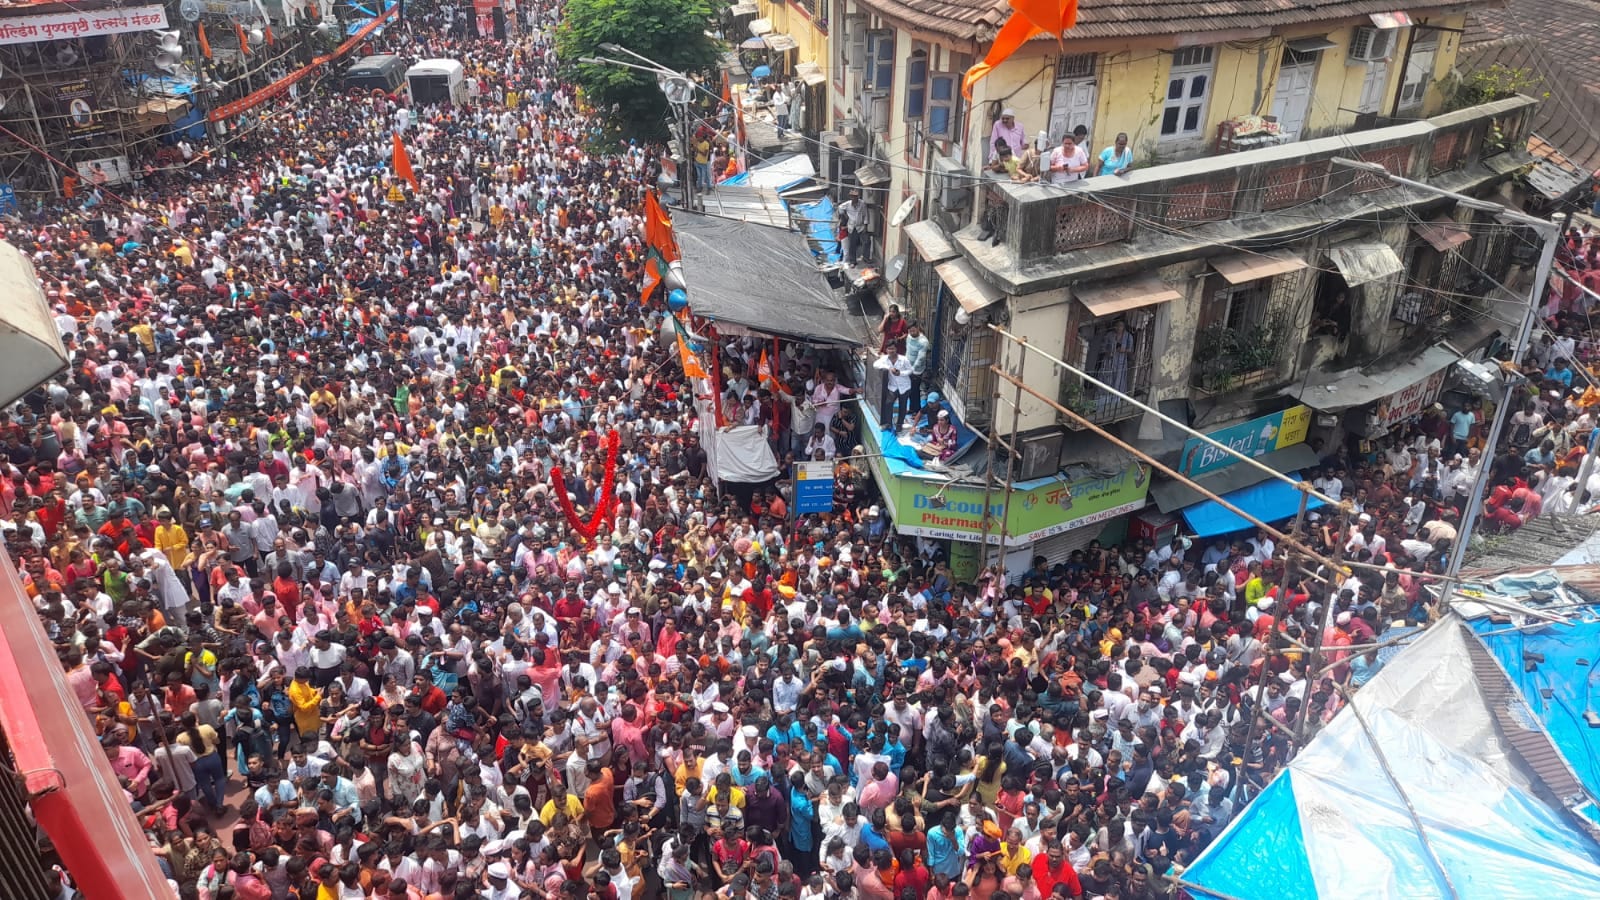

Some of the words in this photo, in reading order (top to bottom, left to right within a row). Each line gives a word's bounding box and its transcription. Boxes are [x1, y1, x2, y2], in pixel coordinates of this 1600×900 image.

[92, 17, 128, 31] उत्सव
[131, 12, 161, 26] मंडळ
[913, 493, 1004, 517] Dcount
[921, 512, 994, 531] Pharmacy
[1028, 531, 1047, 541] SAVE
[1086, 515, 1097, 524] ON
[1098, 503, 1135, 521] MEDICINES
[929, 529, 955, 539] Caring
[956, 532, 968, 540] for
[969, 533, 983, 543] Life
